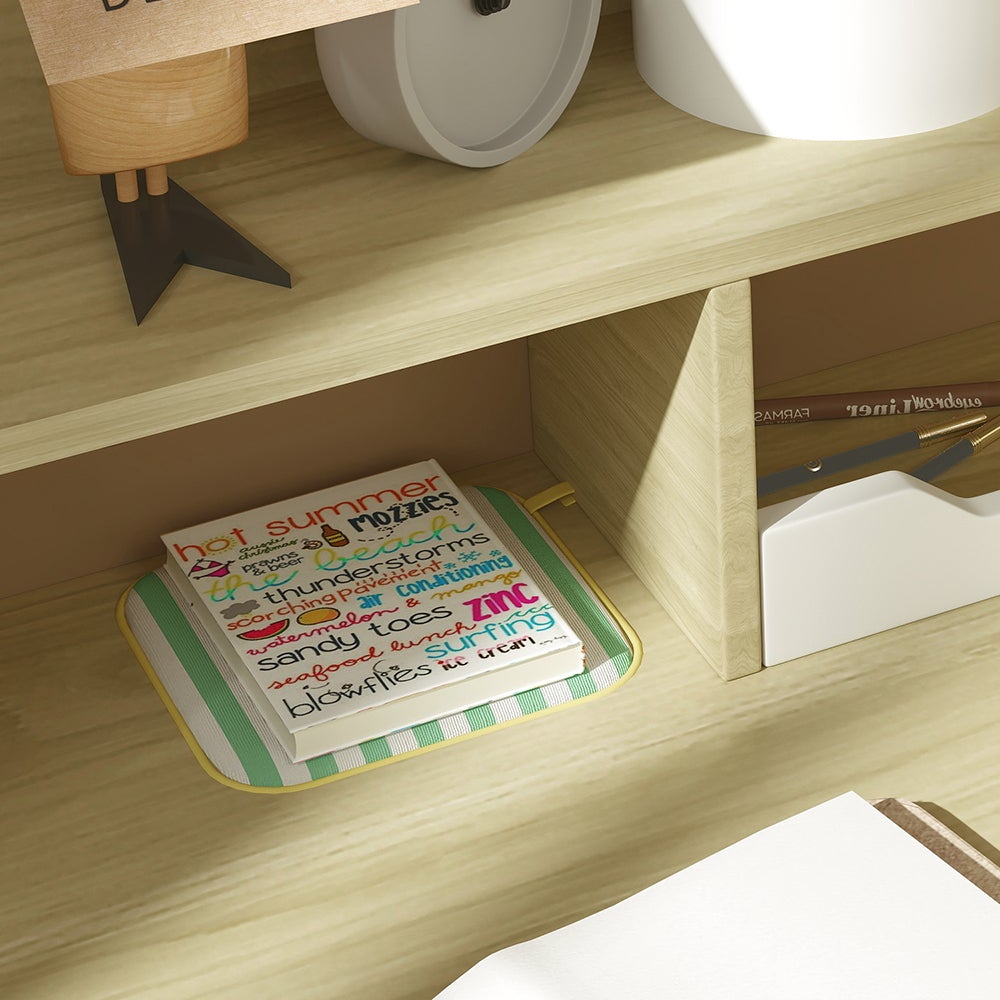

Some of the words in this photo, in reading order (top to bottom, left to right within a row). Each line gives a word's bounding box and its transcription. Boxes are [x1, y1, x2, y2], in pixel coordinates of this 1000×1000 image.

[173, 528, 247, 562] hot
[266, 475, 440, 536] summer
[203, 570, 299, 602] the
[314, 515, 475, 571] beach
[241, 551, 299, 573] prawns
[252, 565, 266, 577] &
[268, 556, 304, 572] beer
[263, 533, 490, 604] thunderstorms
[357, 593, 384, 609] air
[395, 554, 513, 597] conditioning
[227, 593, 337, 631] scorching
[337, 560, 442, 602] pavement
[246, 607, 399, 656] watermelon
[406, 598, 422, 610] &
[430, 568, 523, 600] mango
[257, 633, 360, 671] sandy
[368, 605, 453, 637] toes
[268, 646, 385, 690] seafood
[390, 621, 477, 652] lunch
[425, 611, 555, 659] surfing
[436, 655, 469, 671] ice
[478, 635, 536, 660] cream
[282, 663, 432, 719] blowflies
